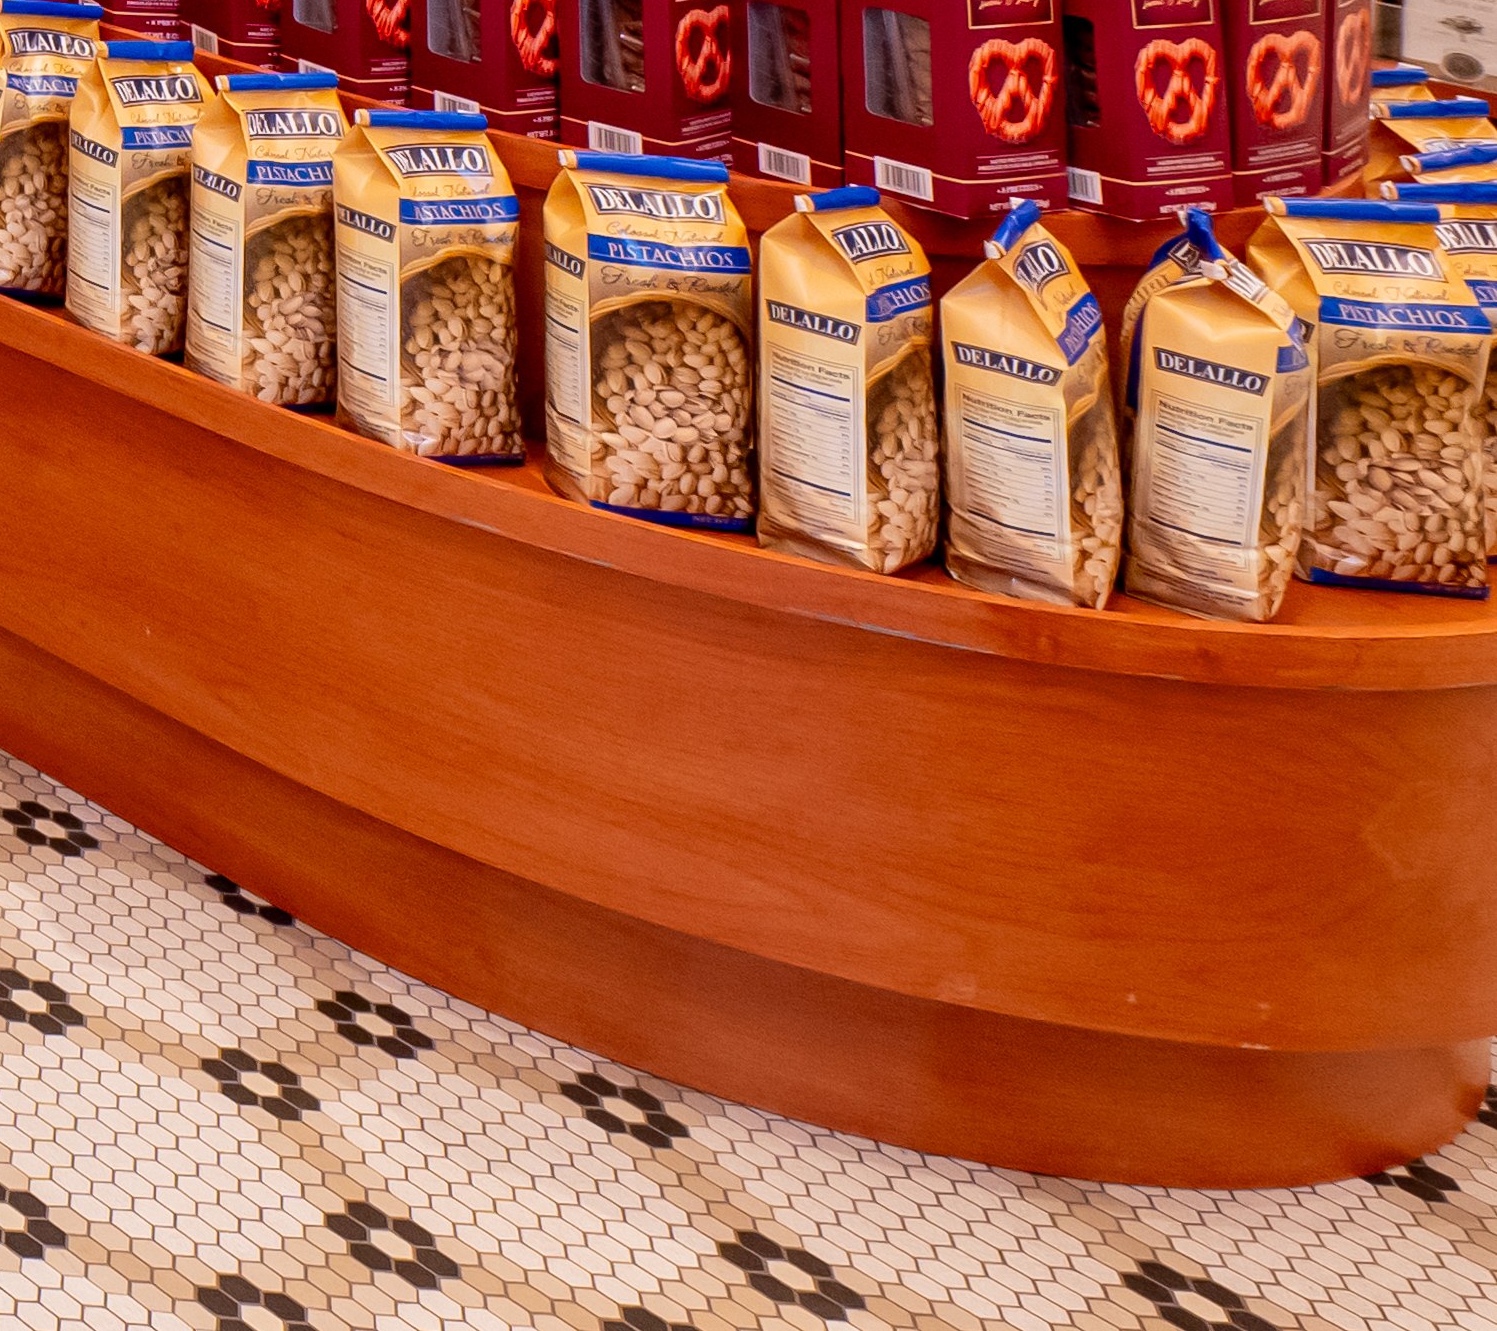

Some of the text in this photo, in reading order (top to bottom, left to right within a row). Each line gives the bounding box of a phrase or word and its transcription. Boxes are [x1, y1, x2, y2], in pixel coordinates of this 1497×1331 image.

[248, 109, 342, 138] DELALLO
[256, 165, 332, 182] PISTACHI
[590, 185, 718, 220] DELALLO
[608, 242, 734, 268] PISTACHIOS
[1309, 239, 1439, 279] DELALLO
[601, 266, 659, 291] Fresh
[1338, 302, 1467, 329] PISTACHIOS
[772, 351, 852, 380] Nutrition Facts
[954, 344, 1060, 384] DELALLO
[1158, 399, 1254, 432] Nutrition Facts
